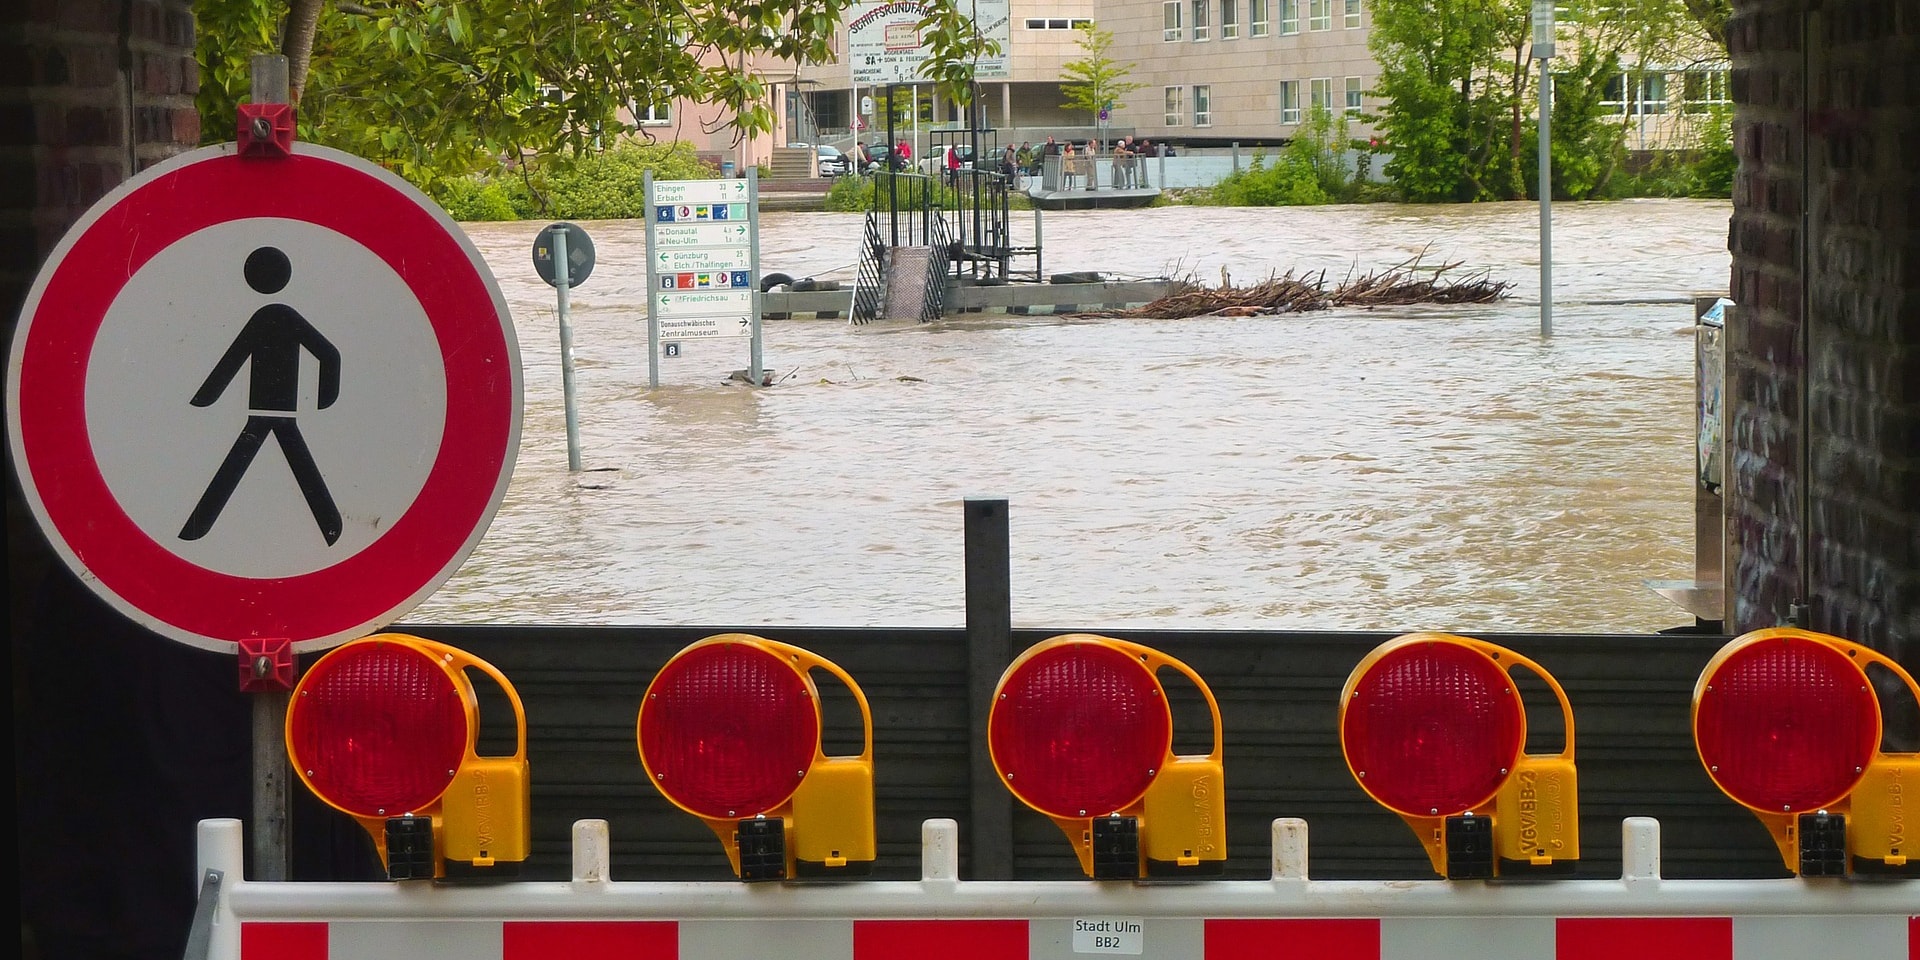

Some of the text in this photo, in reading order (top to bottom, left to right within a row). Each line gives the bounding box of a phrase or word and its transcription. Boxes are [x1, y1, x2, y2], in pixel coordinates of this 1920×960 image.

[865, 56, 876, 65] SA
[656, 183, 727, 193] Ehingen 33
[657, 194, 684, 202] Erbach
[665, 227, 698, 235] Donautal
[665, 236, 699, 245] Neu-Ulm
[674, 250, 743, 260] Günzburg 25
[664, 278, 672, 288] 8
[682, 294, 729, 303] Friedrichsau
[660, 320, 716, 328] Donauschwäbisches
[660, 329, 719, 338] Zentralmuseum
[668, 347, 676, 356] 8
[1519, 768, 1539, 854] VGV/BB-2
[1075, 920, 1141, 933] Stadt Ulm
[1095, 936, 1120, 948] BB2
